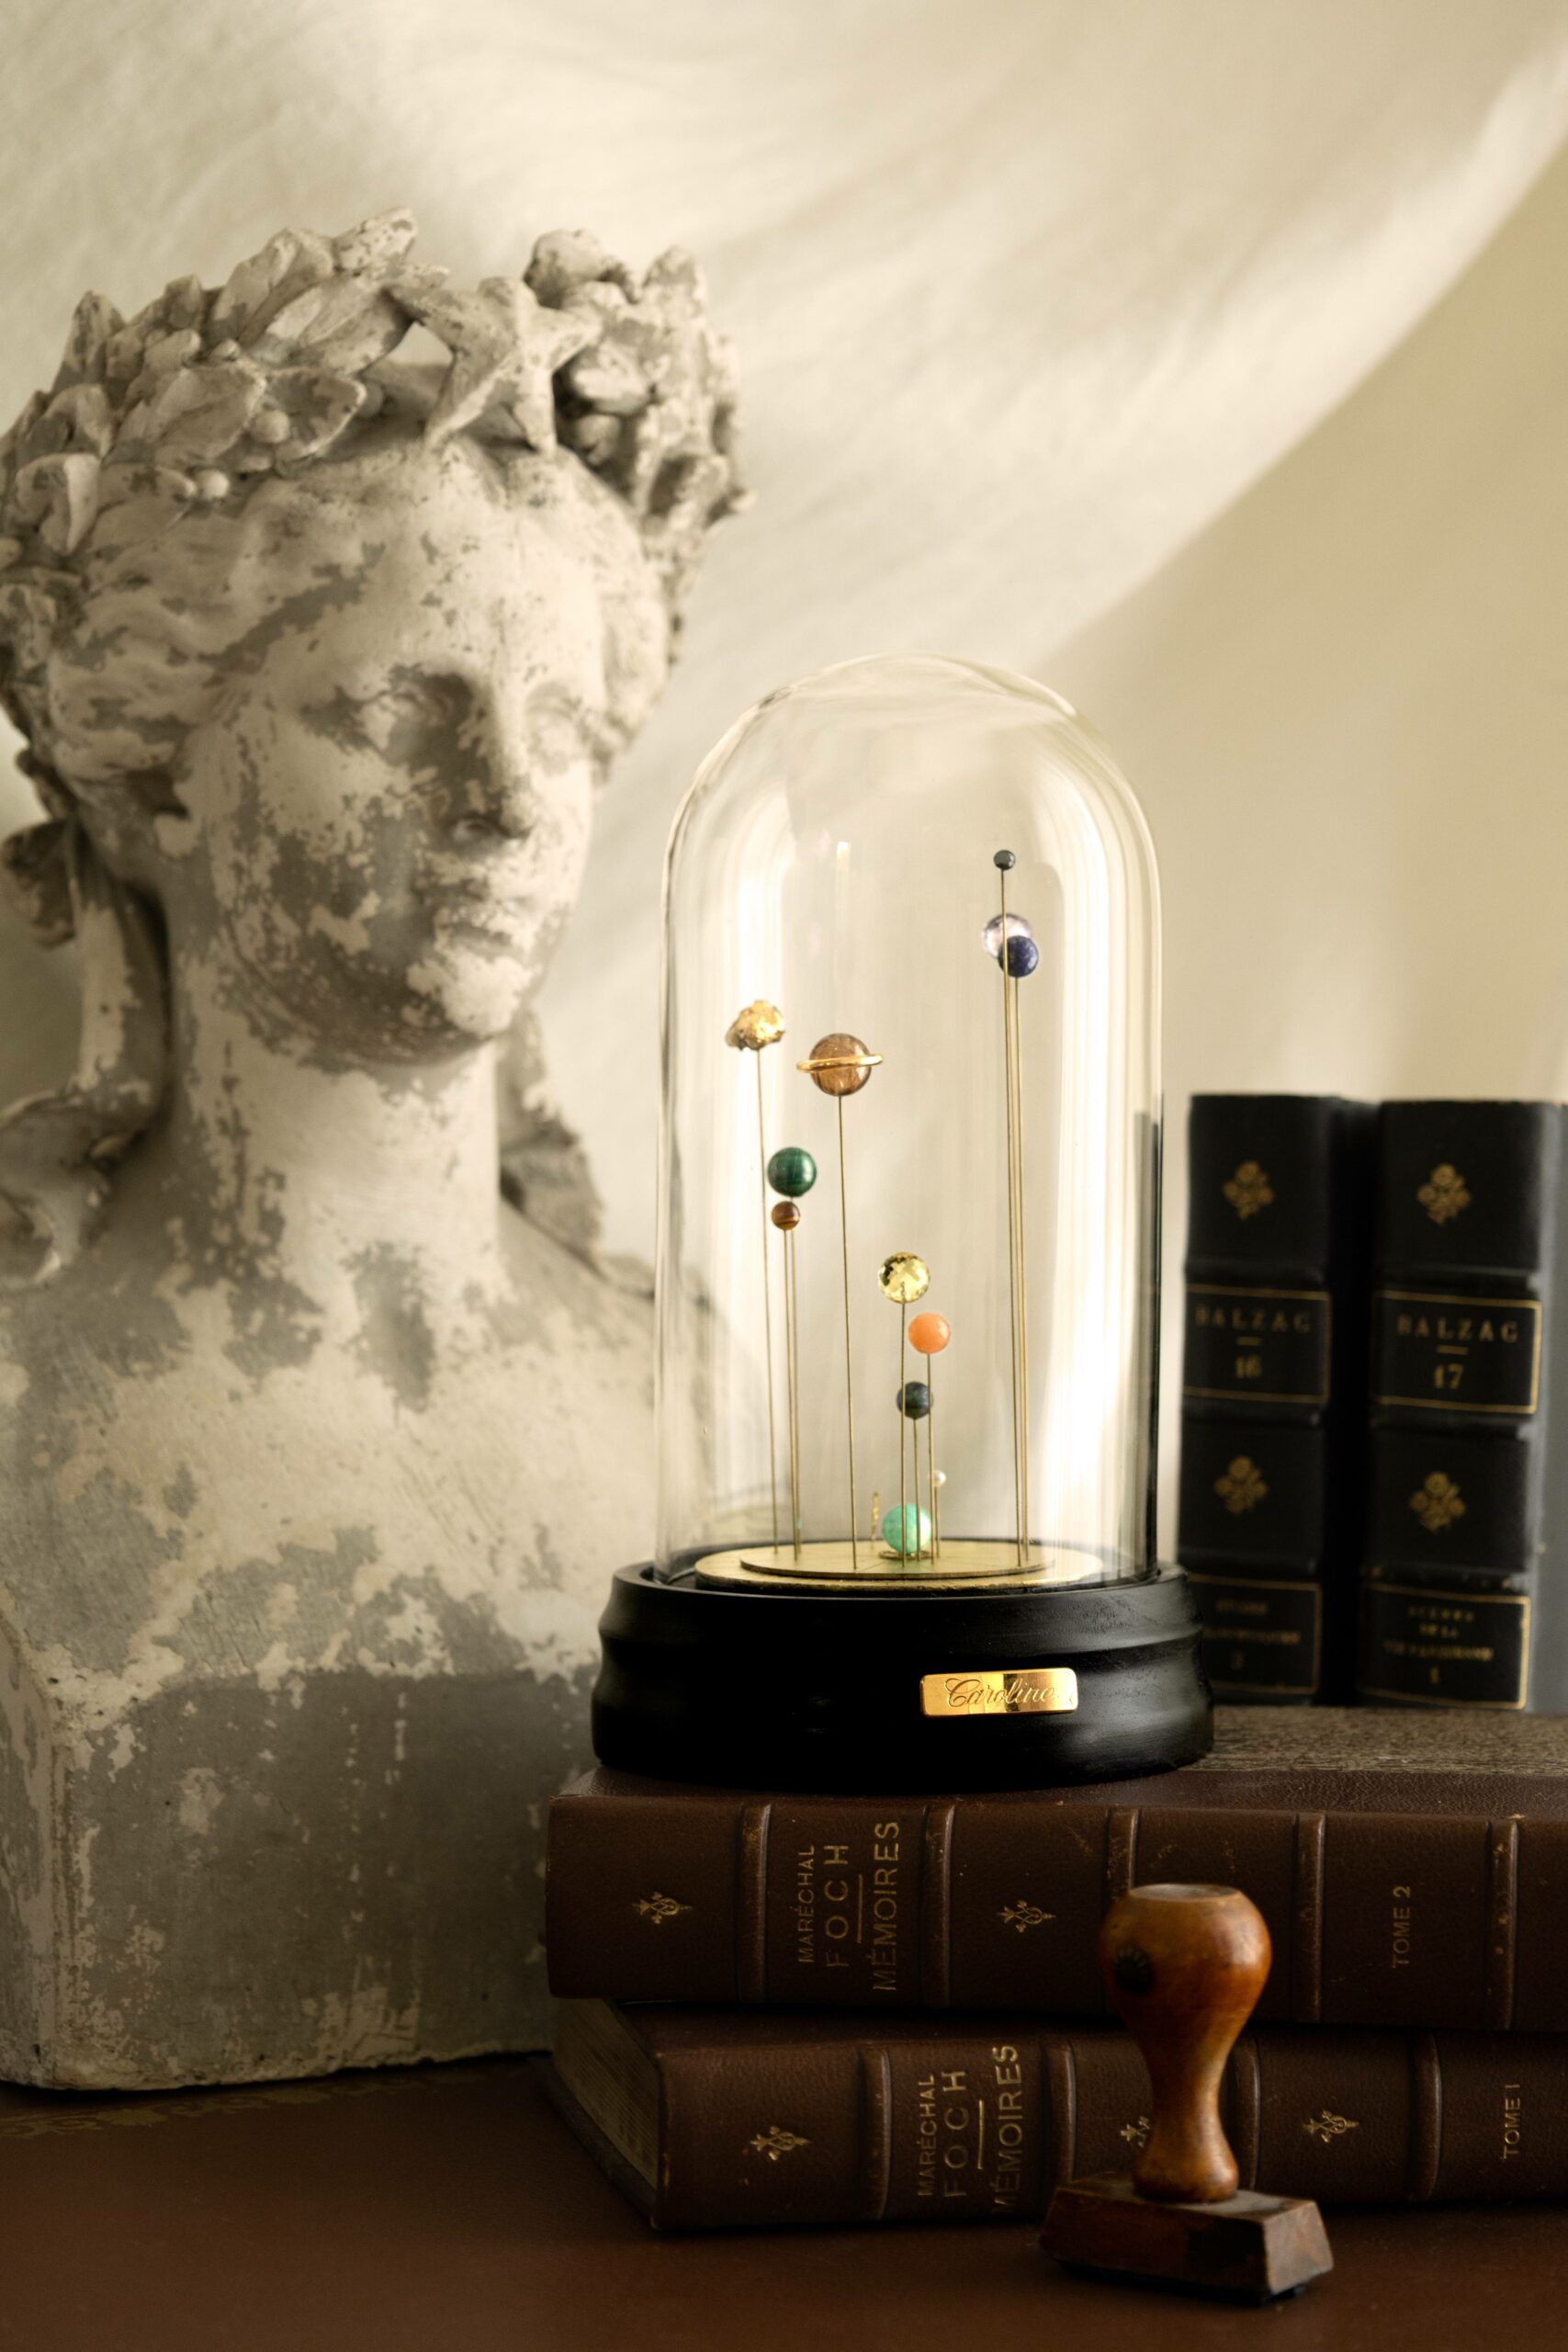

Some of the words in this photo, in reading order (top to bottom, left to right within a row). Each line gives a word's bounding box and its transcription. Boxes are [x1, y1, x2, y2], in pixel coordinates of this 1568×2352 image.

[1194, 1305, 1311, 1333] BALZAC
[1396, 1314, 1519, 1343] BALZAC
[1432, 1363, 1464, 1389] 17
[944, 1678, 1055, 1708] Caroline
[794, 1844, 815, 1963] MARÉCHAL
[823, 1844, 850, 1968] FOCH
[865, 1822, 900, 1992] MÉMOIRES
[1392, 1885, 1411, 1898] 2
[1391, 1906, 1411, 1969] TOME
[915, 2074, 937, 2197] MARÉCHAL
[940, 2070, 970, 2198] FOCH
[989, 2044, 1023, 2213] MÉMOIRES
[1502, 2098, 1520, 2161] TOME
